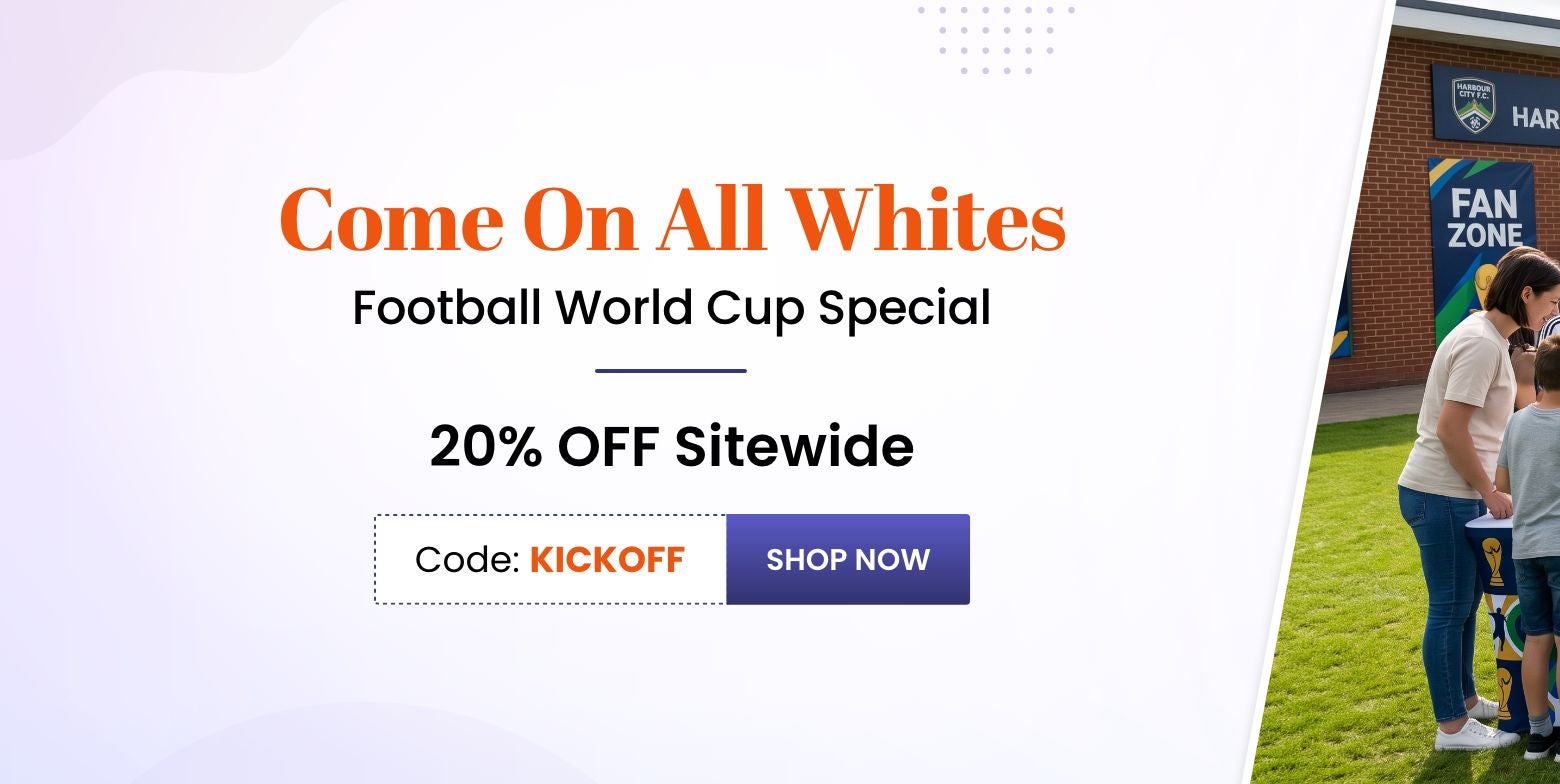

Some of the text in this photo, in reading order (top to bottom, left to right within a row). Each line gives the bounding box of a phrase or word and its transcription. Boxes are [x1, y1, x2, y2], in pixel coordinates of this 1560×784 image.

[1456, 83, 1491, 93] HARBOUR
[1459, 90, 1490, 99] CITY F.C.
[1451, 187, 1518, 219] FAN
[1447, 223, 1524, 248] ZONE
